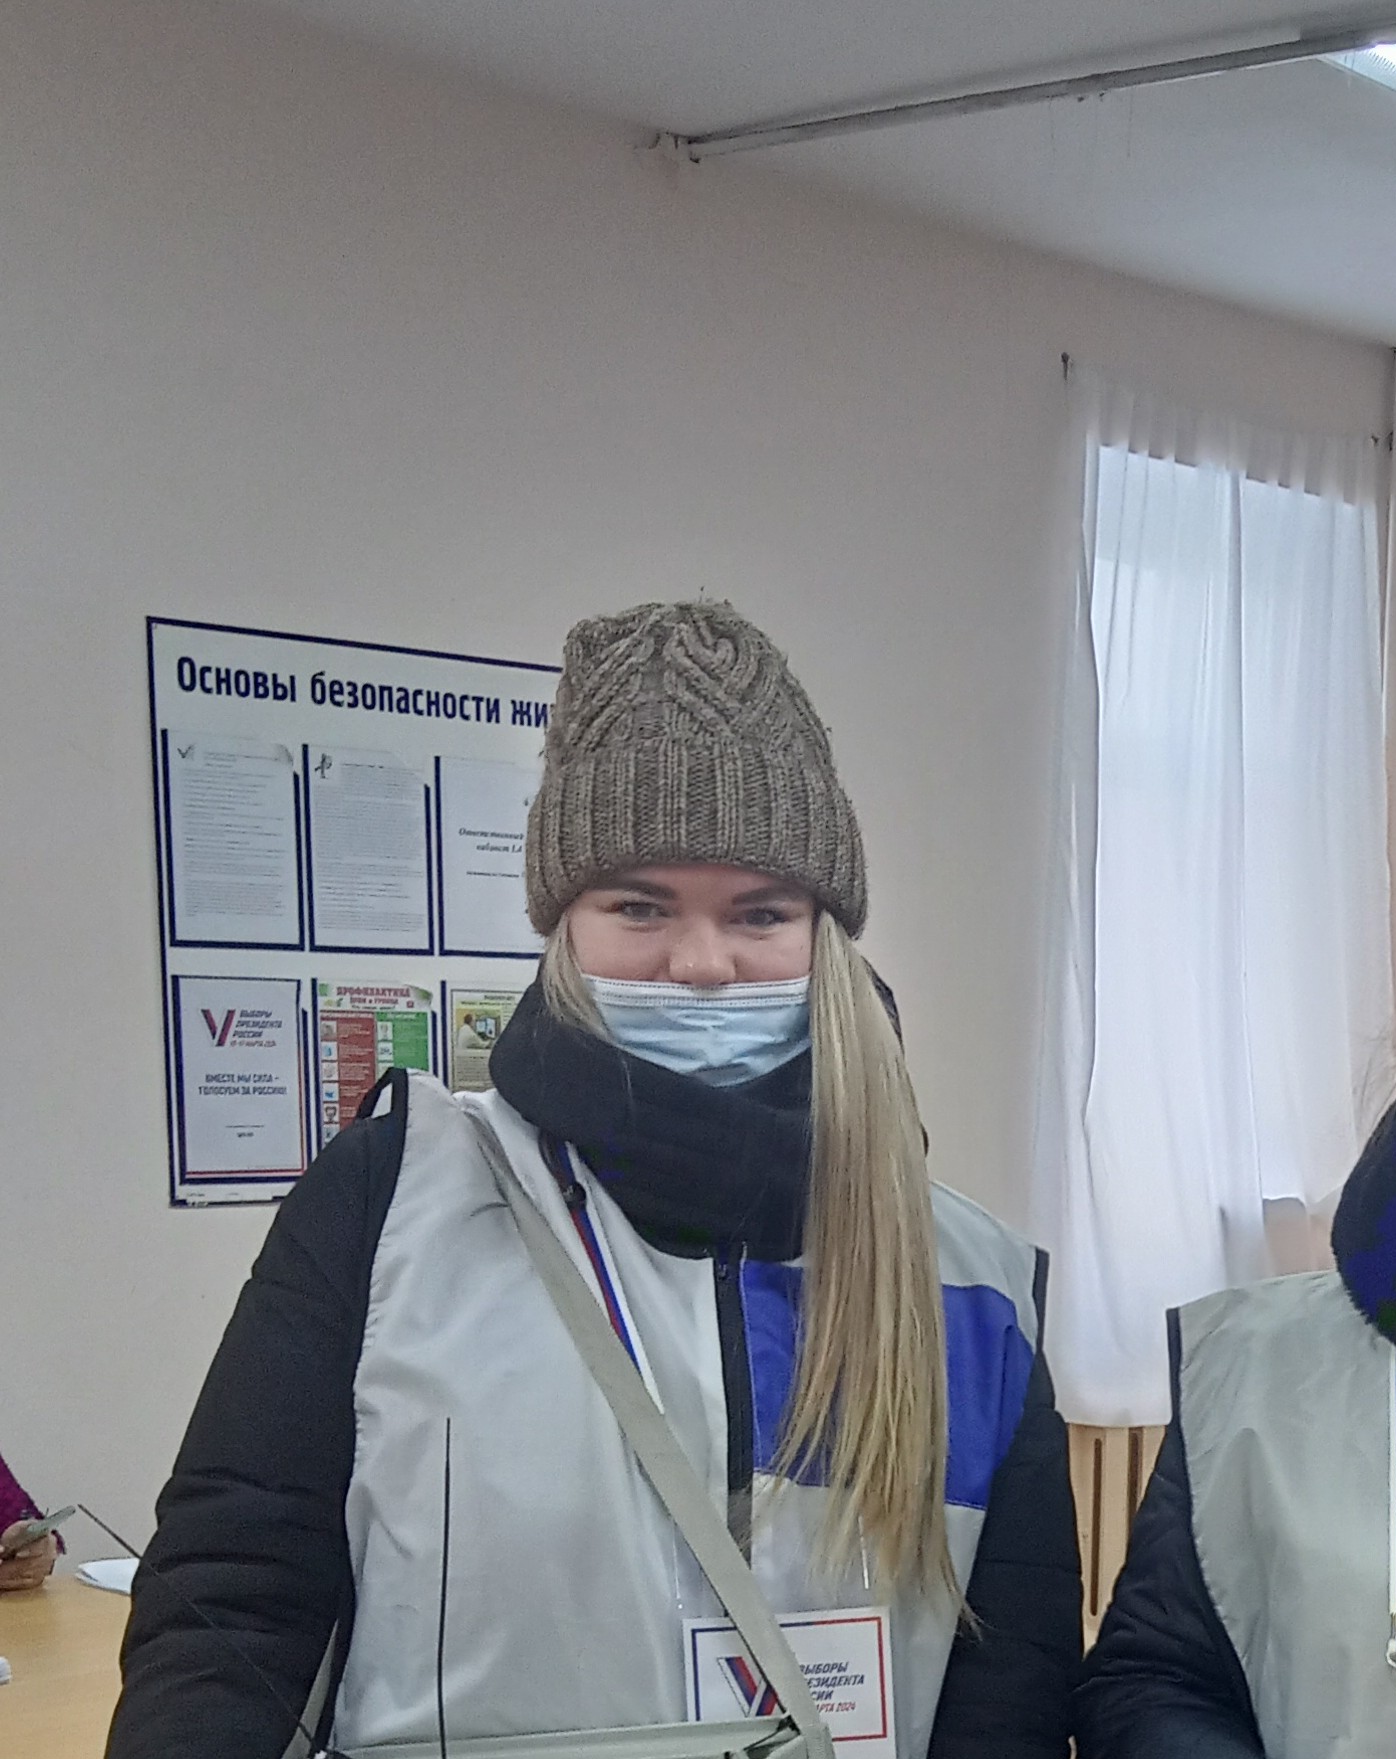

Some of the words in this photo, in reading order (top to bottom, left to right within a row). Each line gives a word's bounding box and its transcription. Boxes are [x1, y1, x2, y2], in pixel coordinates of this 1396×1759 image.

[176, 655, 297, 703] Основы
[310, 670, 501, 724] безопасности
[510, 699, 548, 728] жи
[806, 1674, 865, 1689] ЕЗИДЕНТА
[810, 1689, 834, 1701] СИИ
